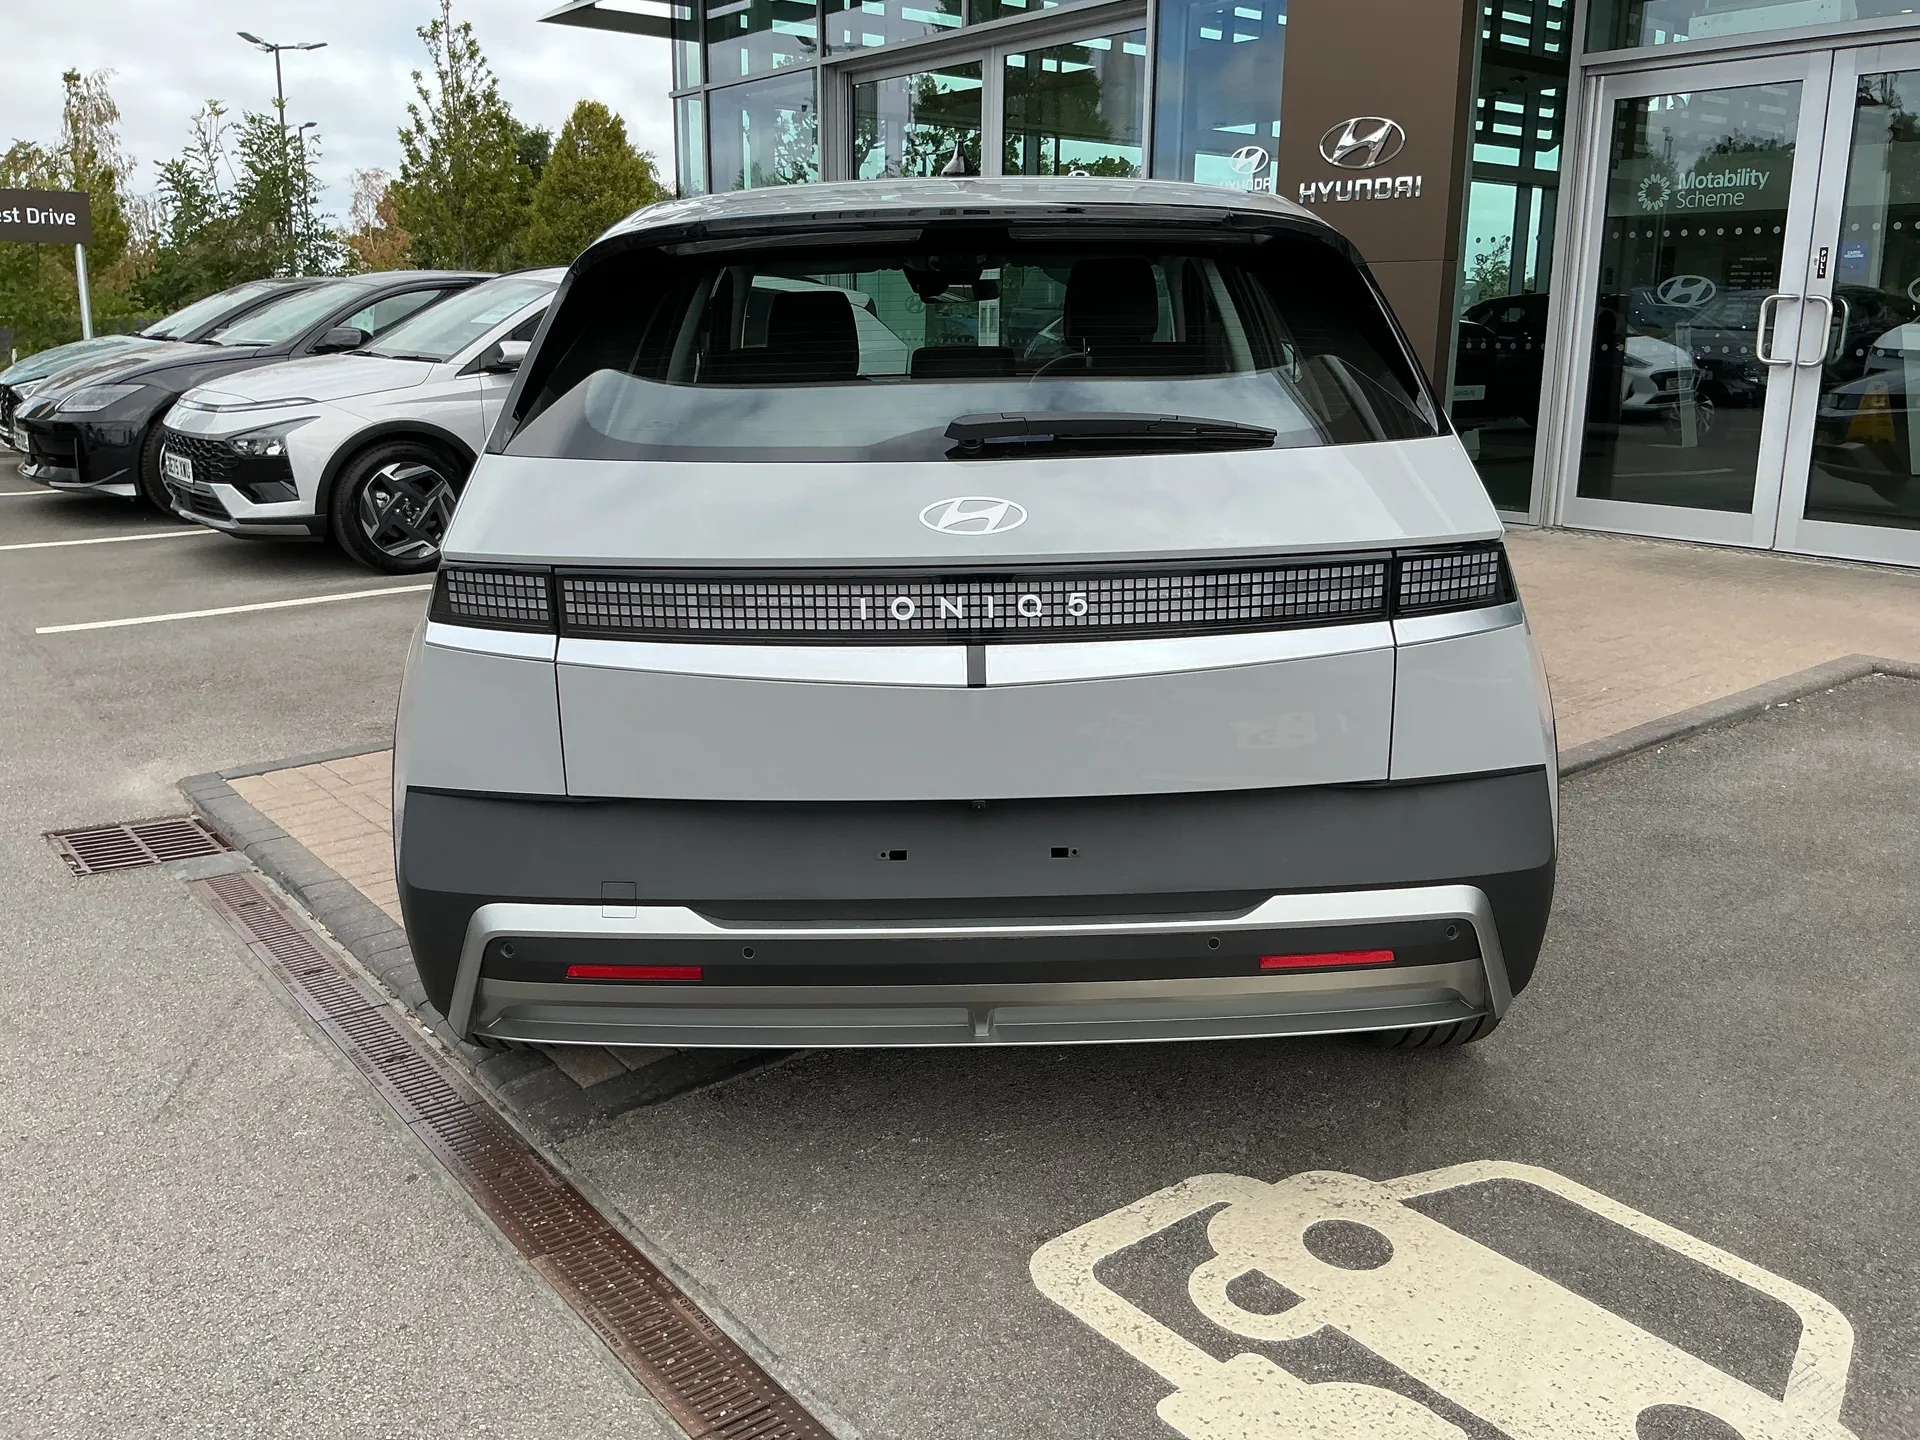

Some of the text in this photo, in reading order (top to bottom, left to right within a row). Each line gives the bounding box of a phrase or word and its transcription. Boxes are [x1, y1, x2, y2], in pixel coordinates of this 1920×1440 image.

[1299, 176, 1422, 204] HYUNDAI
[1678, 168, 1770, 190] Motability
[1676, 191, 1745, 209] Scheme
[0, 207, 76, 226] st Drive
[1819, 249, 1828, 276] PULL
